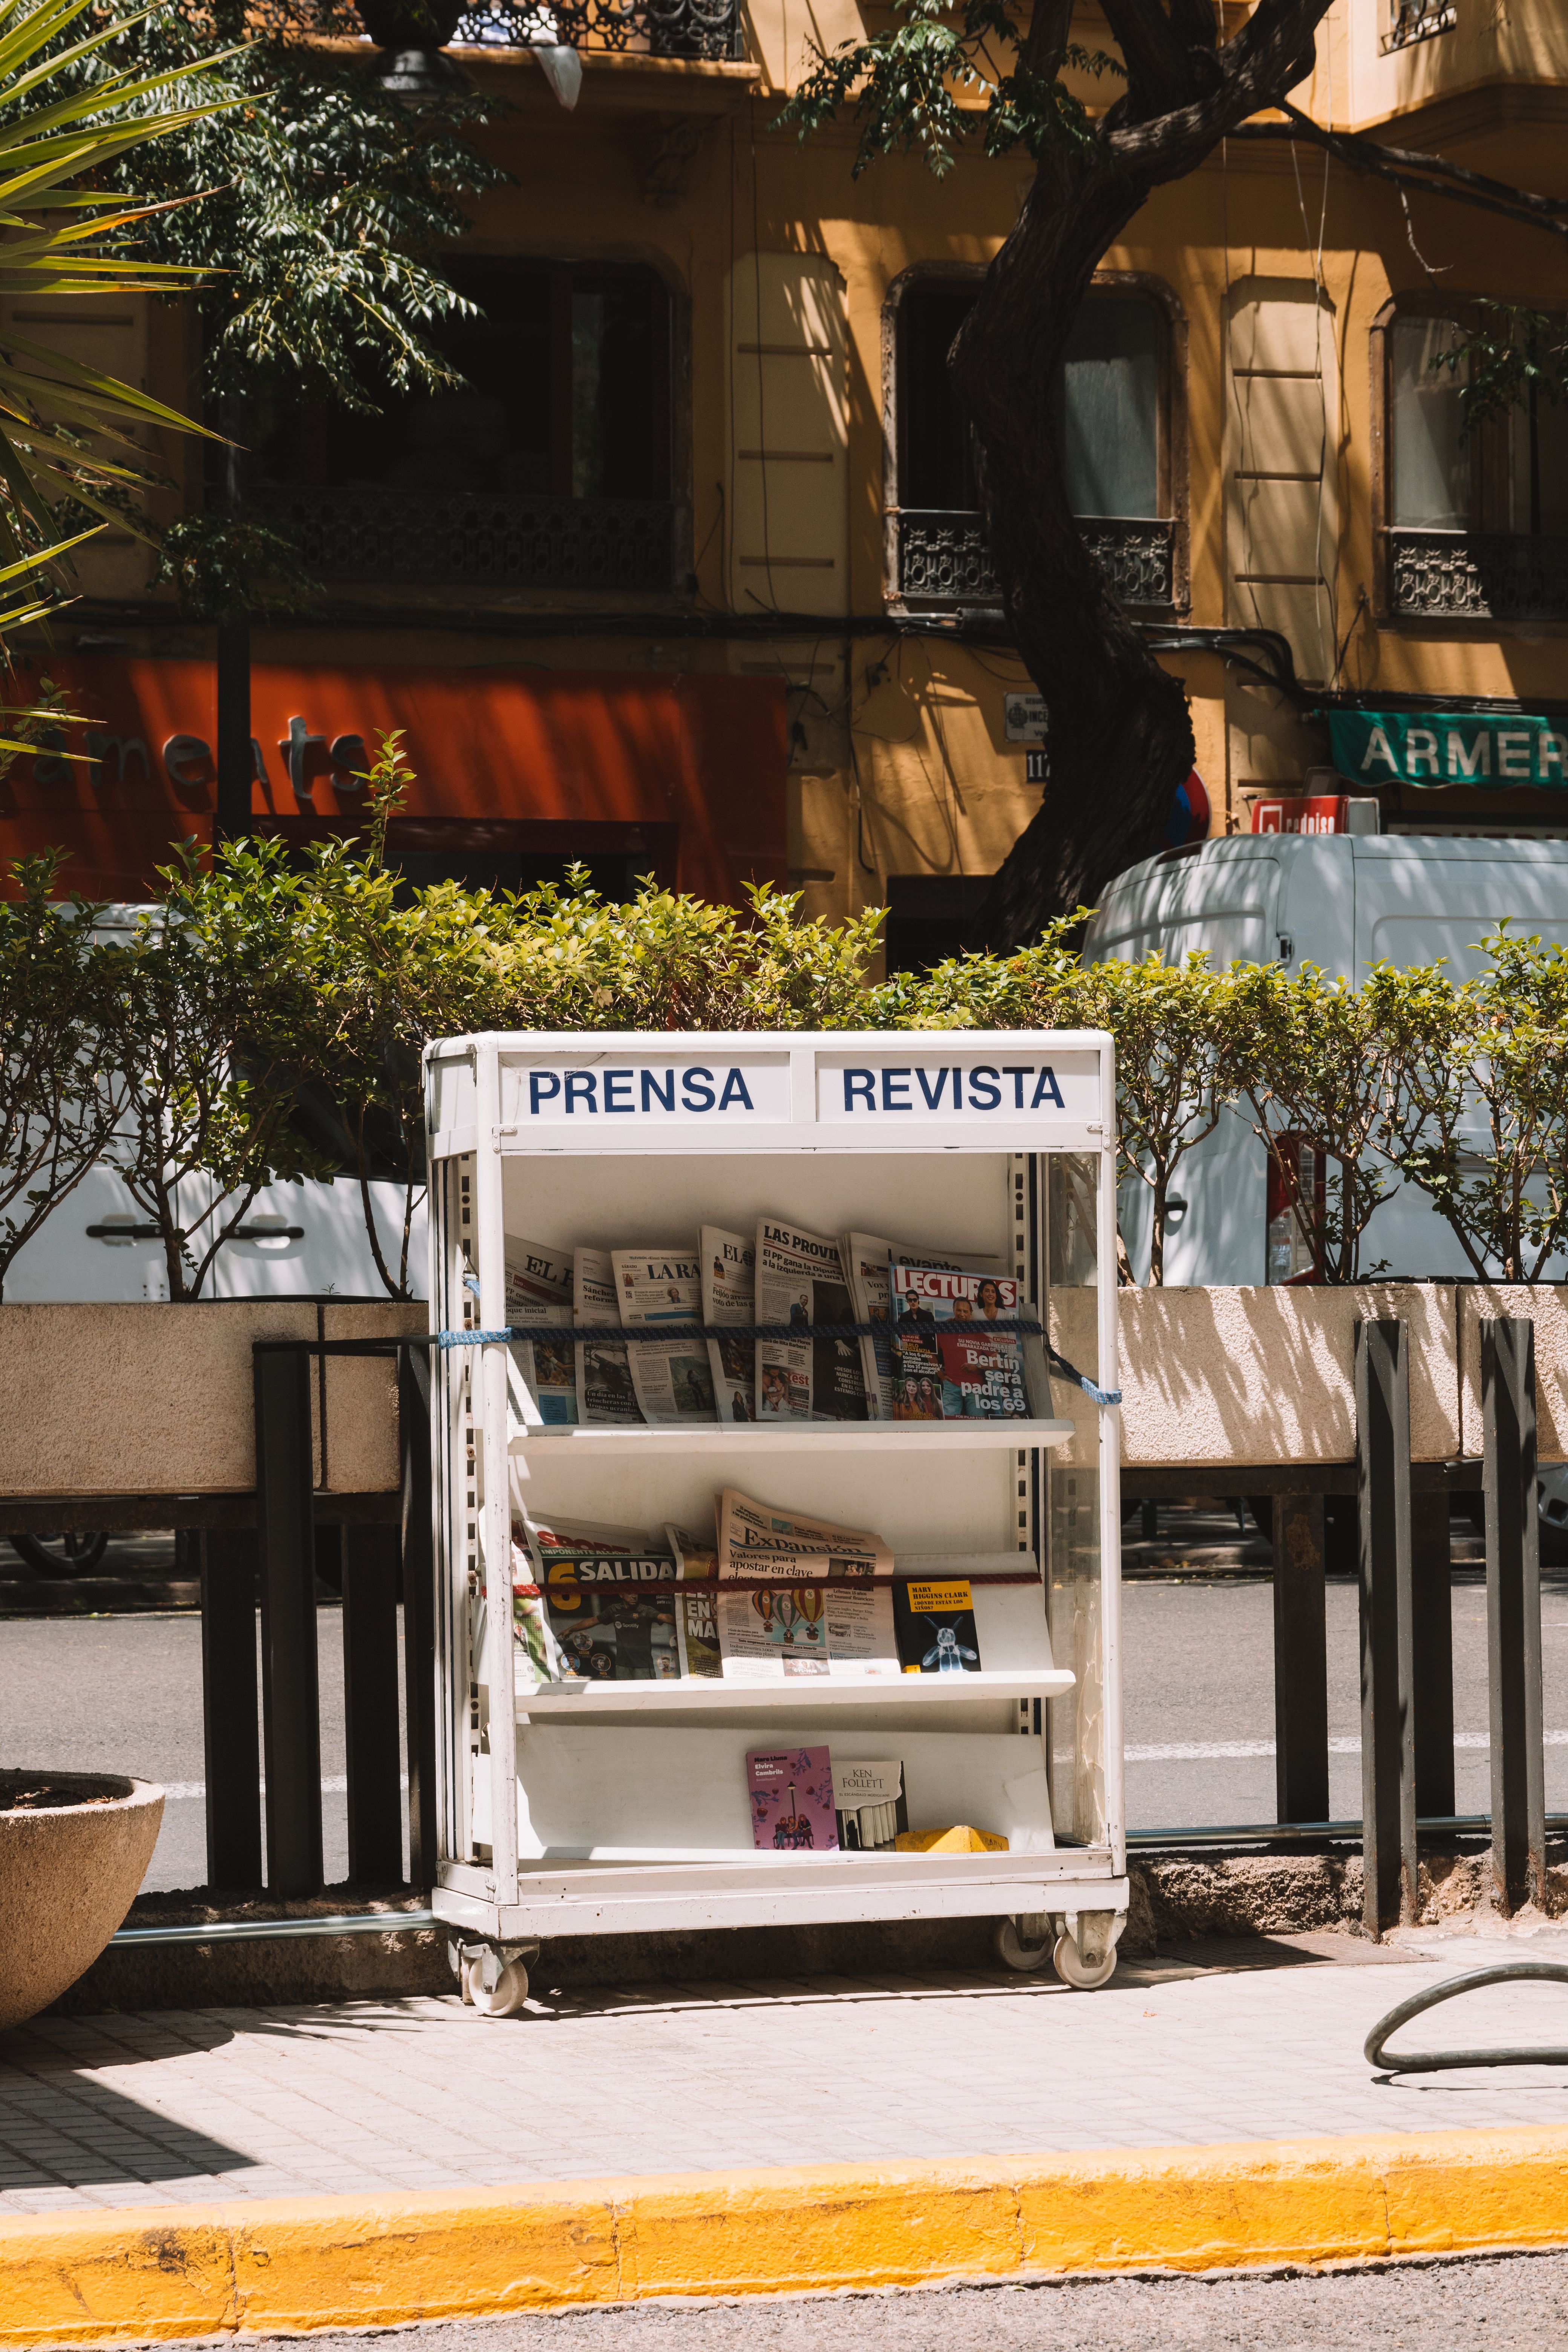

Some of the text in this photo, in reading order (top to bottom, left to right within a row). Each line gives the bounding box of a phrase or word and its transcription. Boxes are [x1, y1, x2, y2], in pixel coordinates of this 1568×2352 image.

[0, 715, 365, 800] amets
[530, 1068, 754, 1115] PRENSA
[844, 1067, 1065, 1111] REVISTA
[764, 1225, 790, 1245] LAS
[763, 1249, 770, 1257] El
[772, 1252, 782, 1261] PP
[784, 1258, 802, 1269] gana
[769, 1260, 775, 1269] la
[777, 1263, 816, 1274] izquierda
[525, 1254, 557, 1282] EL
[646, 1264, 675, 1280] LA
[713, 1286, 729, 1298] Feijóo
[896, 1266, 1014, 1305] LECTURS
[506, 1295, 528, 1307] alianz
[712, 1297, 724, 1307] voto
[957, 1343, 989, 1351] EMBARAZADA
[966, 1349, 1020, 1370] Bertín
[787, 1372, 809, 1386] test
[985, 1369, 1022, 1385] será
[834, 1387, 856, 1395] ESTEMOS
[961, 1381, 1024, 1399] padre a
[975, 1395, 1026, 1411] los 69
[744, 1526, 862, 1553] Expansión
[729, 1549, 796, 1563] Valores para
[729, 1560, 770, 1574] apostar
[771, 1565, 785, 1574] en
[786, 1568, 813, 1578] clave
[548, 1562, 676, 1610] 6 SALIDA
[686, 1600, 710, 1618] EN
[853, 1769, 872, 1778] KEN
[842, 1778, 885, 1789] FOLLETT
